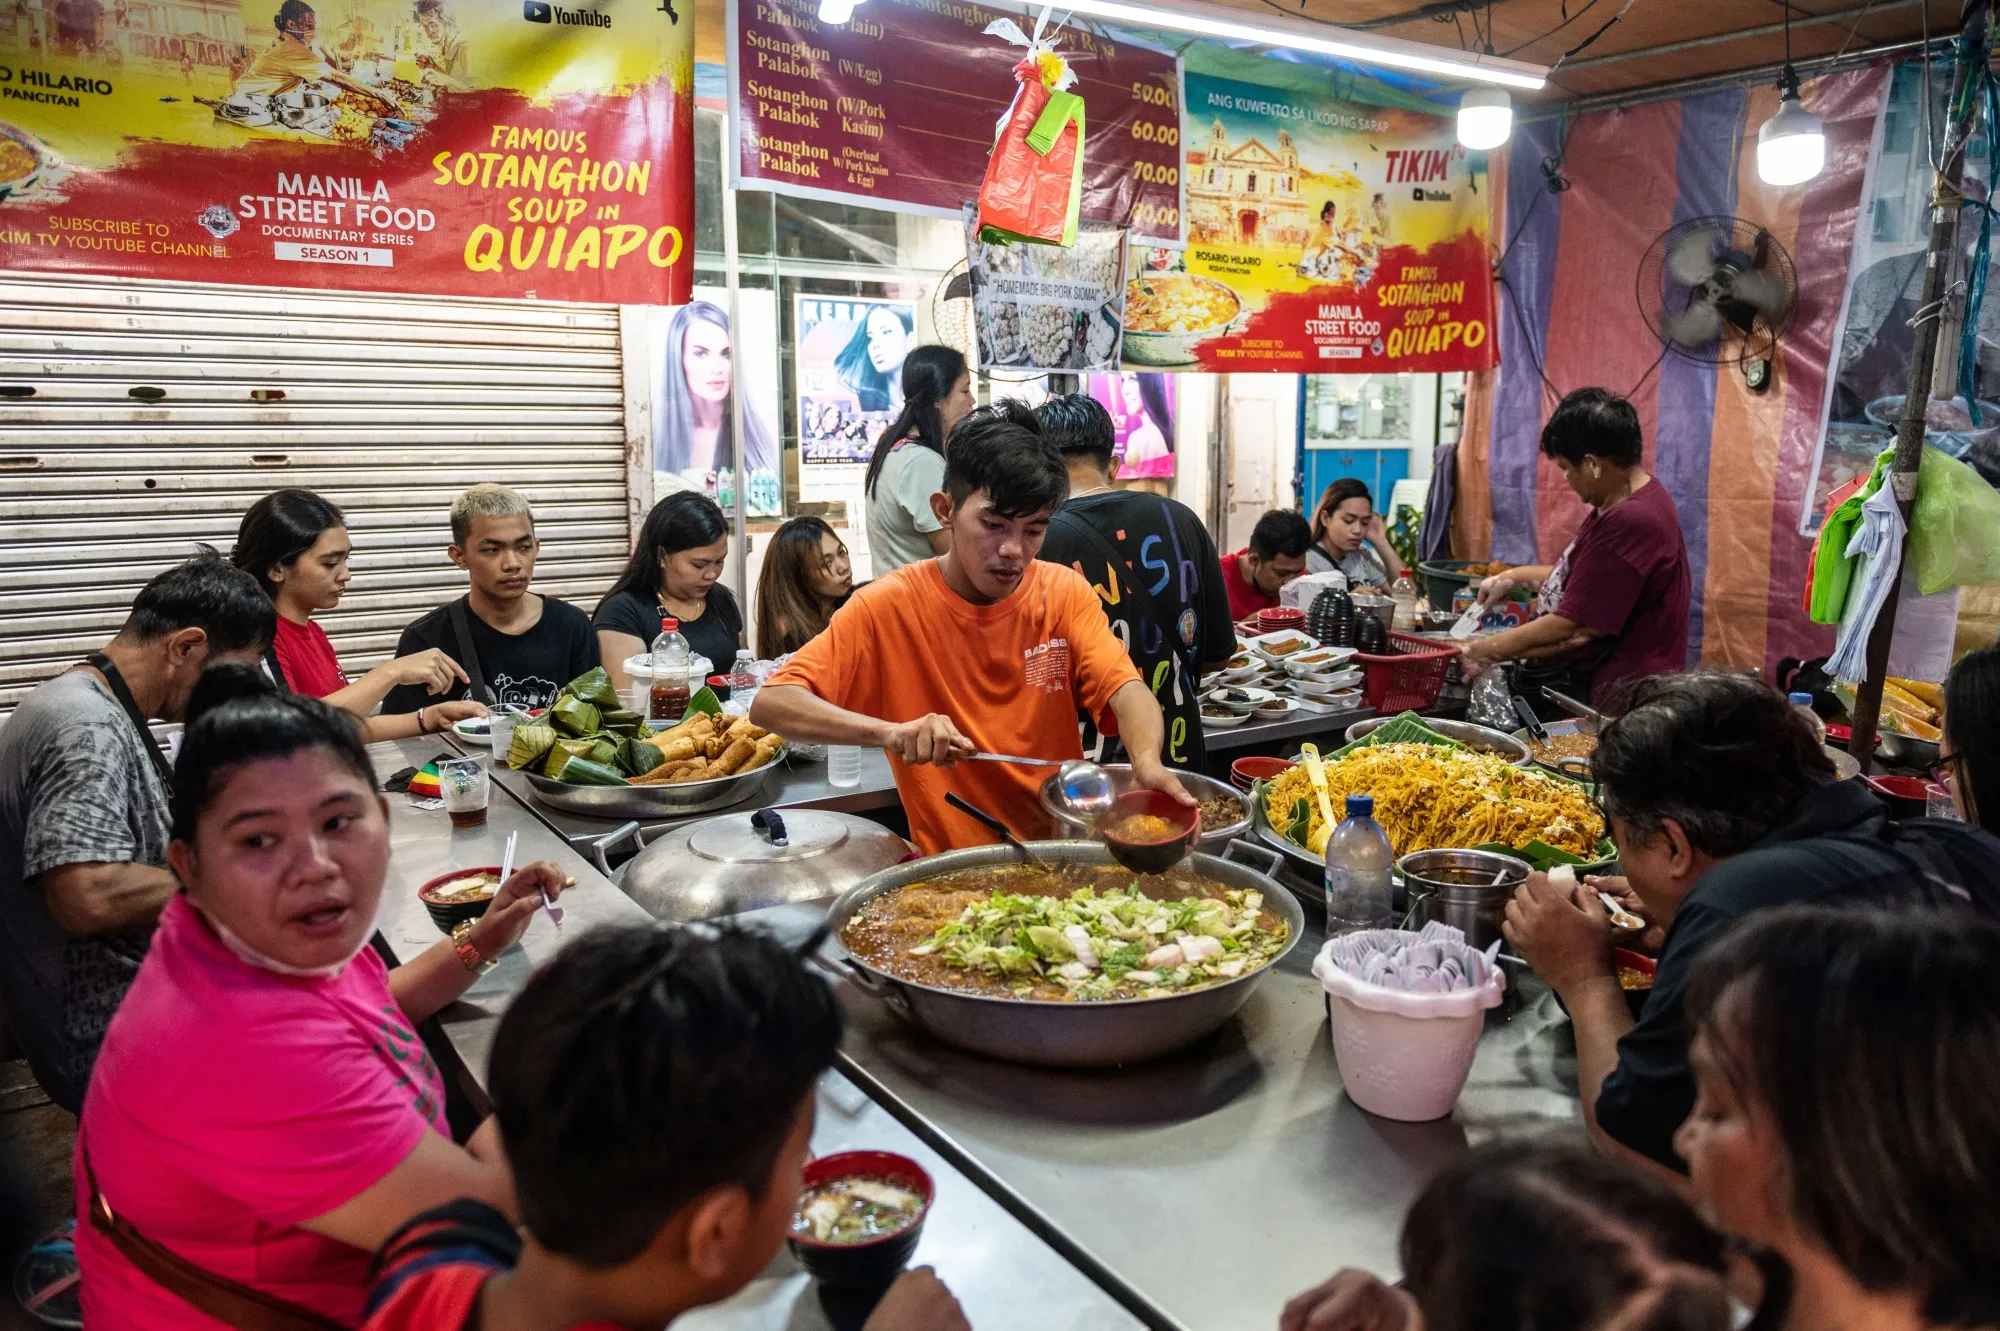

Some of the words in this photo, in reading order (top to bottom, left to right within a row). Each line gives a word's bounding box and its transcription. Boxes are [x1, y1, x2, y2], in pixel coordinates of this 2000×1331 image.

[553, 6, 611, 28] YouTube
[756, 5, 820, 34] Palabok
[746, 30, 830, 62] Sotanghon
[20, 68, 113, 95] HILARIO
[757, 52, 820, 80] Palabok
[838, 58, 883, 85] (W/Egg)
[3, 87, 80, 107] PANCITAN
[747, 80, 829, 112] Sotanghon
[836, 96, 886, 120] (W/Pork
[758, 102, 820, 129] Palabok
[842, 117, 884, 141] Kasim)
[1207, 93, 1232, 109] ANG
[1235, 98, 1290, 118] KUWENTO
[1292, 107, 1306, 121] SA
[1308, 109, 1339, 126] LIKOD
[1340, 115, 1357, 129] NG
[490, 125, 587, 152] FAMOUS
[1131, 120, 1179, 146] 60.00
[750, 133, 829, 161] Sotanghon
[842, 147, 880, 163] (Overload
[432, 151, 651, 196] SOTANGHON
[760, 153, 820, 178] Palabok
[845, 158, 864, 173] Pork
[865, 161, 889, 177] Kasim
[1133, 160, 1179, 185] 70.00
[1386, 150, 1450, 183] TIKIM
[277, 172, 391, 203] MANILA
[856, 173, 875, 189] Egg)
[239, 195, 350, 225] STREET
[356, 205, 436, 232] FOOD
[507, 196, 588, 224] SOUP
[597, 204, 620, 221] IN
[49, 216, 141, 235] SUBSCRIBE
[146, 223, 170, 237] TO
[262, 224, 366, 243] DOCUMENTARY
[371, 232, 414, 246] SERIES
[37, 232, 60, 246] TV
[64, 235, 147, 253] YOUTUBE
[151, 241, 232, 259] CHANNEL
[300, 247, 359, 261] SEASON
[362, 251, 370, 262] 1
[464, 223, 683, 272] QUIAPO
[1196, 251, 1229, 264] ROSARIO
[1231, 256, 1261, 267] HILARIO
[1401, 266, 1438, 282] FAMOUS
[1041, 283, 1053, 297] BIG
[1054, 285, 1072, 298] PORK
[1377, 281, 1465, 307] SOTANGHON
[1318, 304, 1363, 320] MANILA
[1404, 308, 1435, 327] SOUP
[1305, 319, 1345, 335] STREET
[1349, 320, 1381, 336] FOOD
[1387, 320, 1486, 359] QUIAPO
[1025, 638, 1067, 659] BADSS
